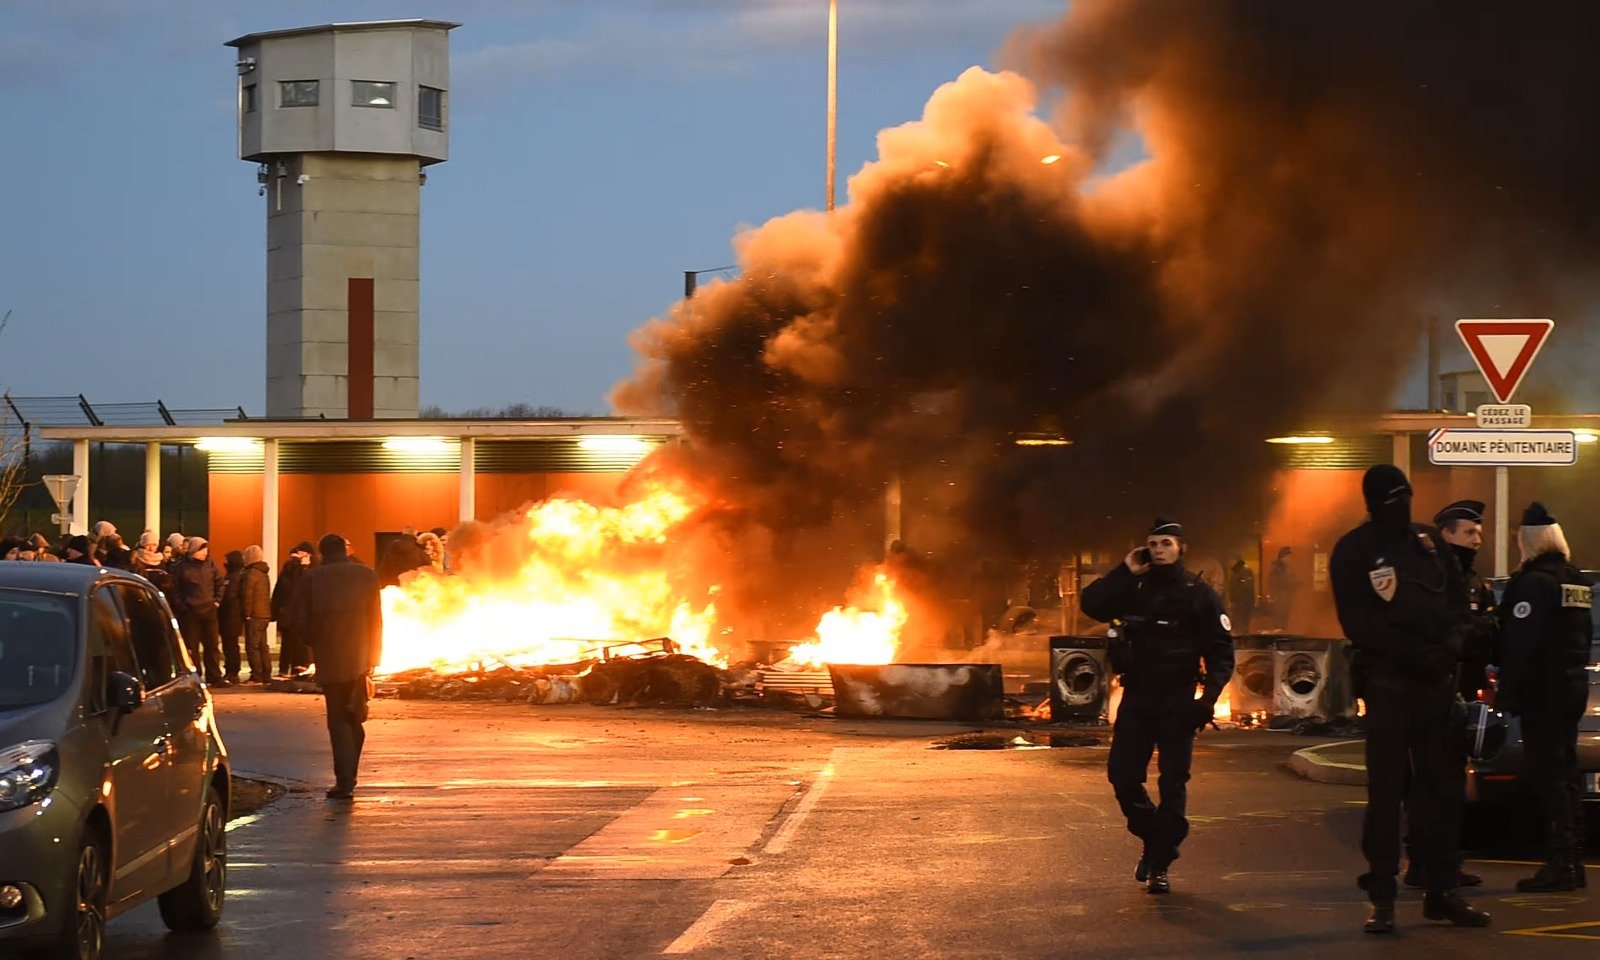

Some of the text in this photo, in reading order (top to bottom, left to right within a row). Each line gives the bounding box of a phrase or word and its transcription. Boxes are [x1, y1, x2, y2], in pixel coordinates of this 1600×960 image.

[1514, 408, 1524, 416] LE
[1482, 417, 1524, 425] PASSAGE
[1436, 439, 1572, 454] DOMAINE PÉNITENTIAIRE
